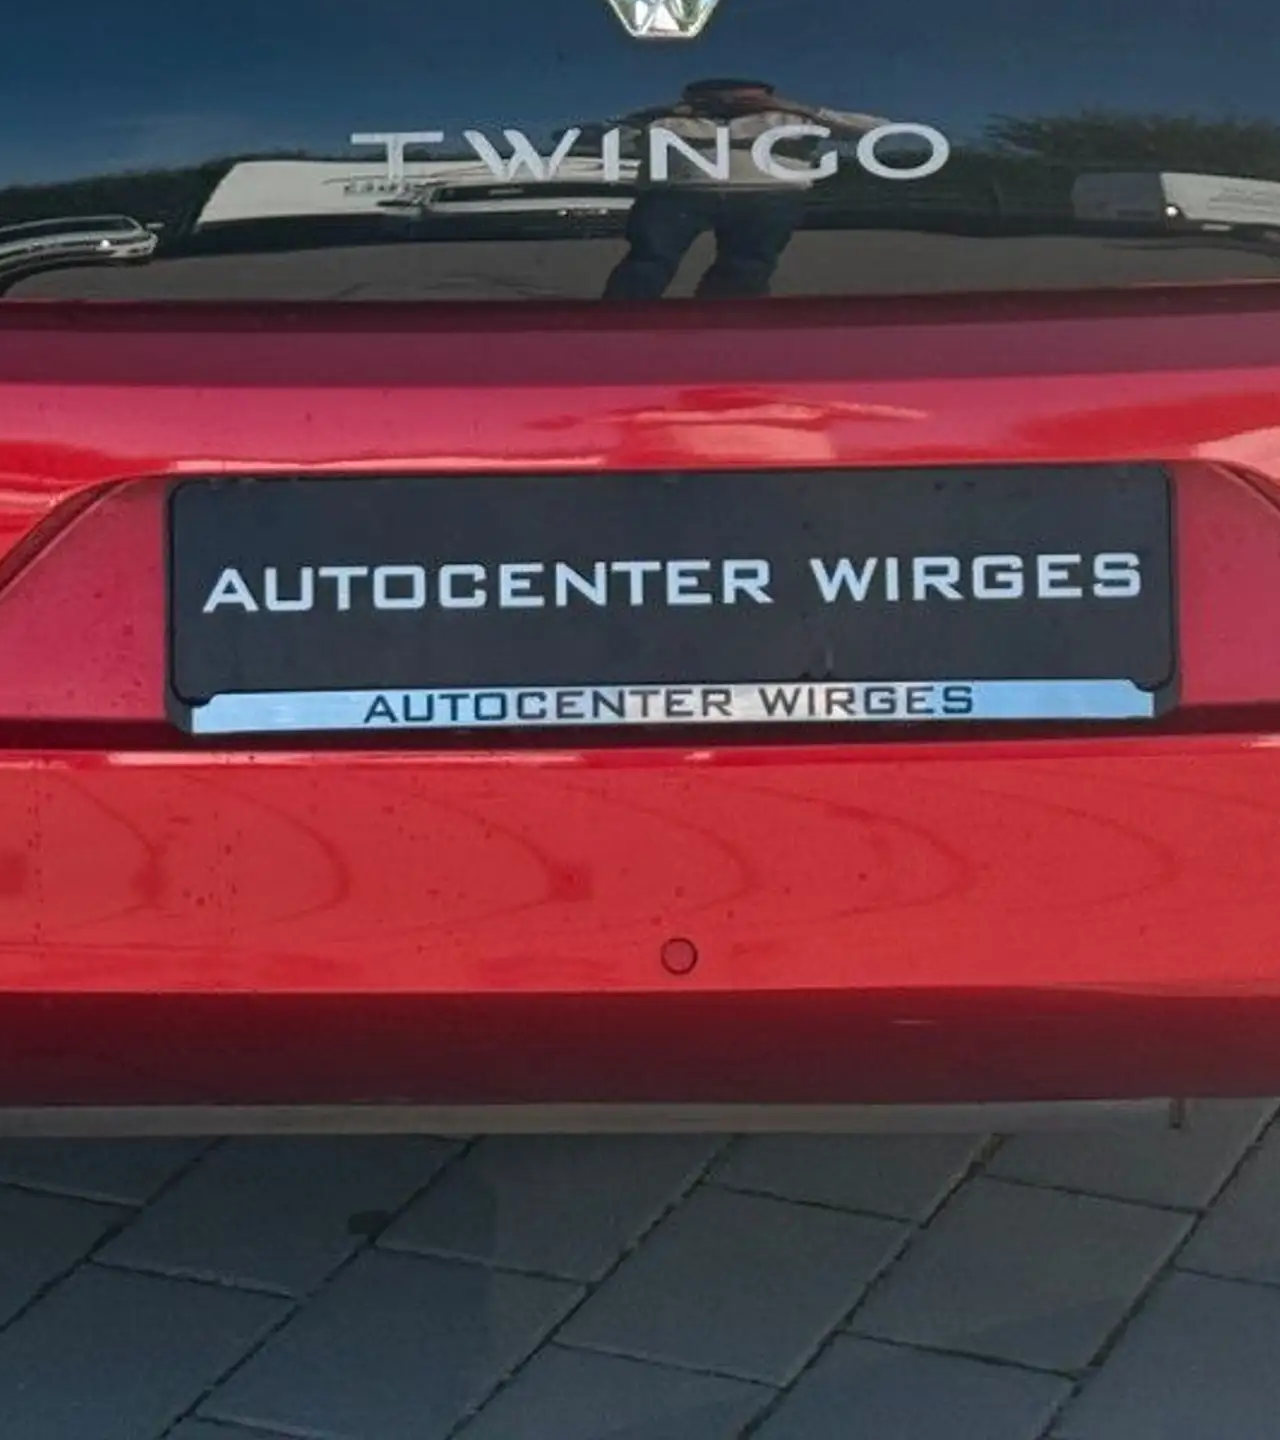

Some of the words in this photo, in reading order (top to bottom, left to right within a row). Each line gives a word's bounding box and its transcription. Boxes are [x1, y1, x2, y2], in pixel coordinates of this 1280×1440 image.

[350, 122, 950, 182] TWINGO
[203, 559, 774, 613] AUTOCENTER
[809, 552, 1143, 603] WIRGES
[363, 688, 733, 724] AUTOCENTER
[758, 685, 973, 717] WIRGES
